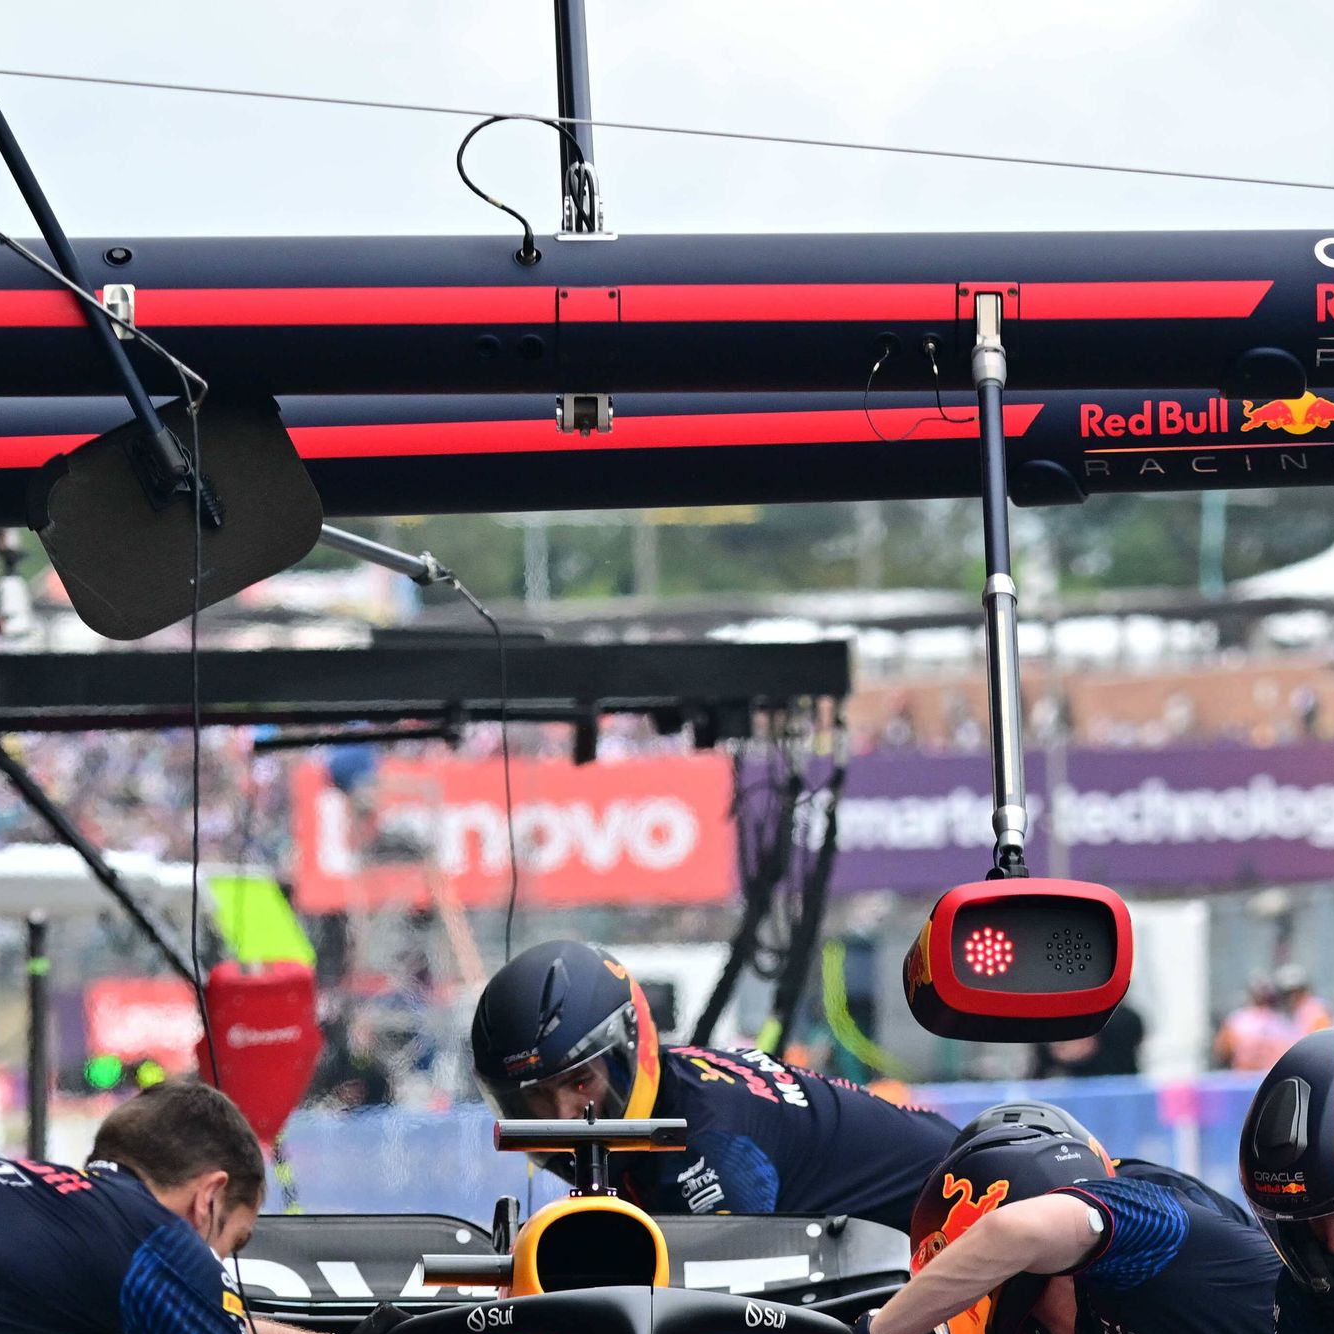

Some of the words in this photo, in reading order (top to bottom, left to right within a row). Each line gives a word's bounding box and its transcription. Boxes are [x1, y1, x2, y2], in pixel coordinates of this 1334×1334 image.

[1080, 400, 1154, 438] Red
[1158, 397, 1228, 434] Bull
[1254, 1171, 1305, 1182] ORACLE
[488, 1306, 514, 1326] Sui
[764, 1308, 786, 1329] Sui
